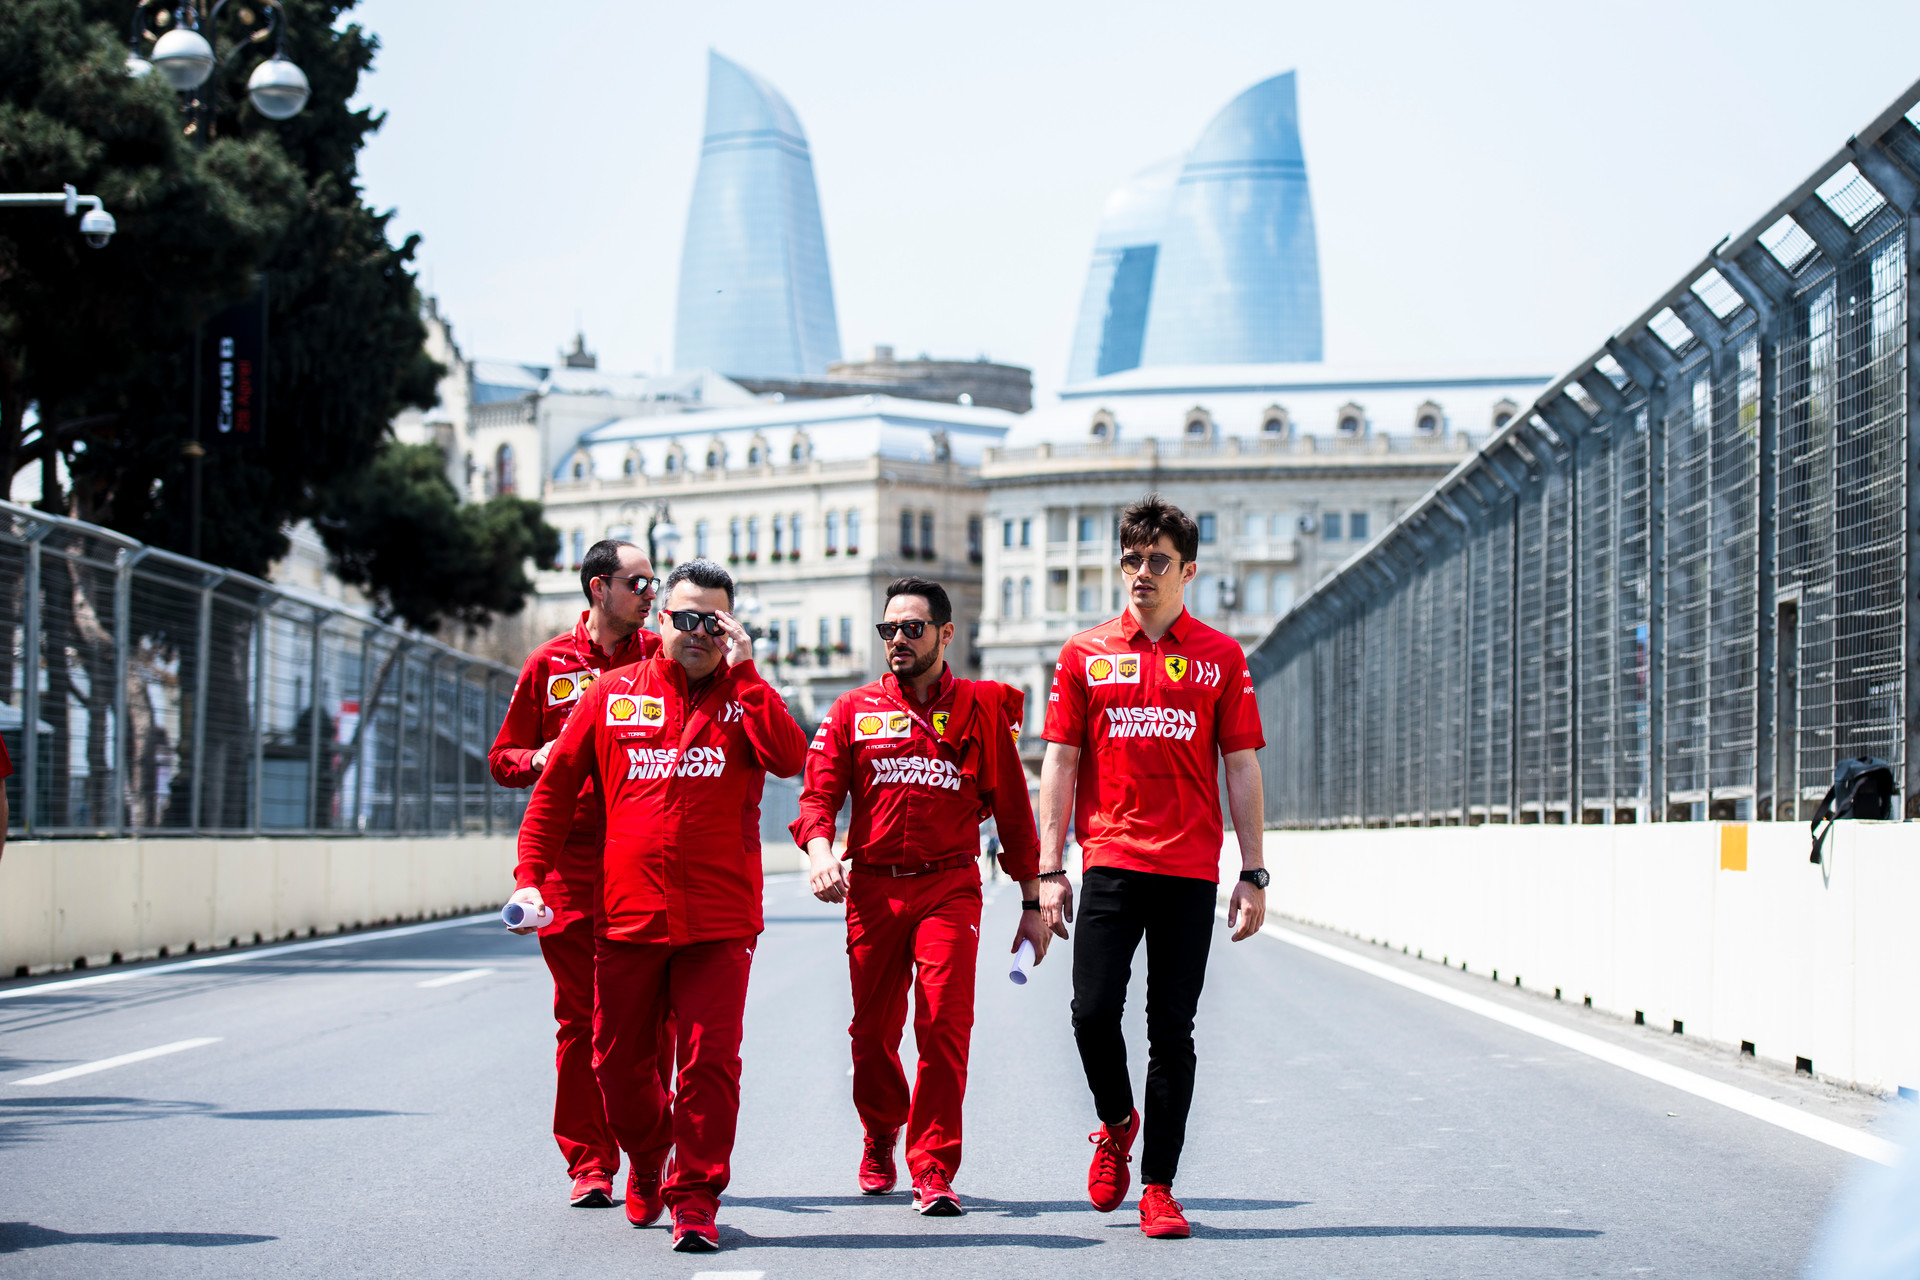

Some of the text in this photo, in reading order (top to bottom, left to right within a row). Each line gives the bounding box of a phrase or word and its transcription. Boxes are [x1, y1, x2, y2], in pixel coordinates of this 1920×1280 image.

[1120, 664, 1137, 676] ups
[643, 704, 661, 719] ups
[1105, 707, 1197, 727] MISSION
[890, 719, 908, 731] ups
[1108, 722, 1197, 741] WINNOW
[627, 746, 726, 764] MISSION
[627, 761, 726, 780] WINNOW
[871, 756, 961, 776] MISSION
[871, 769, 962, 791] WINNOW
